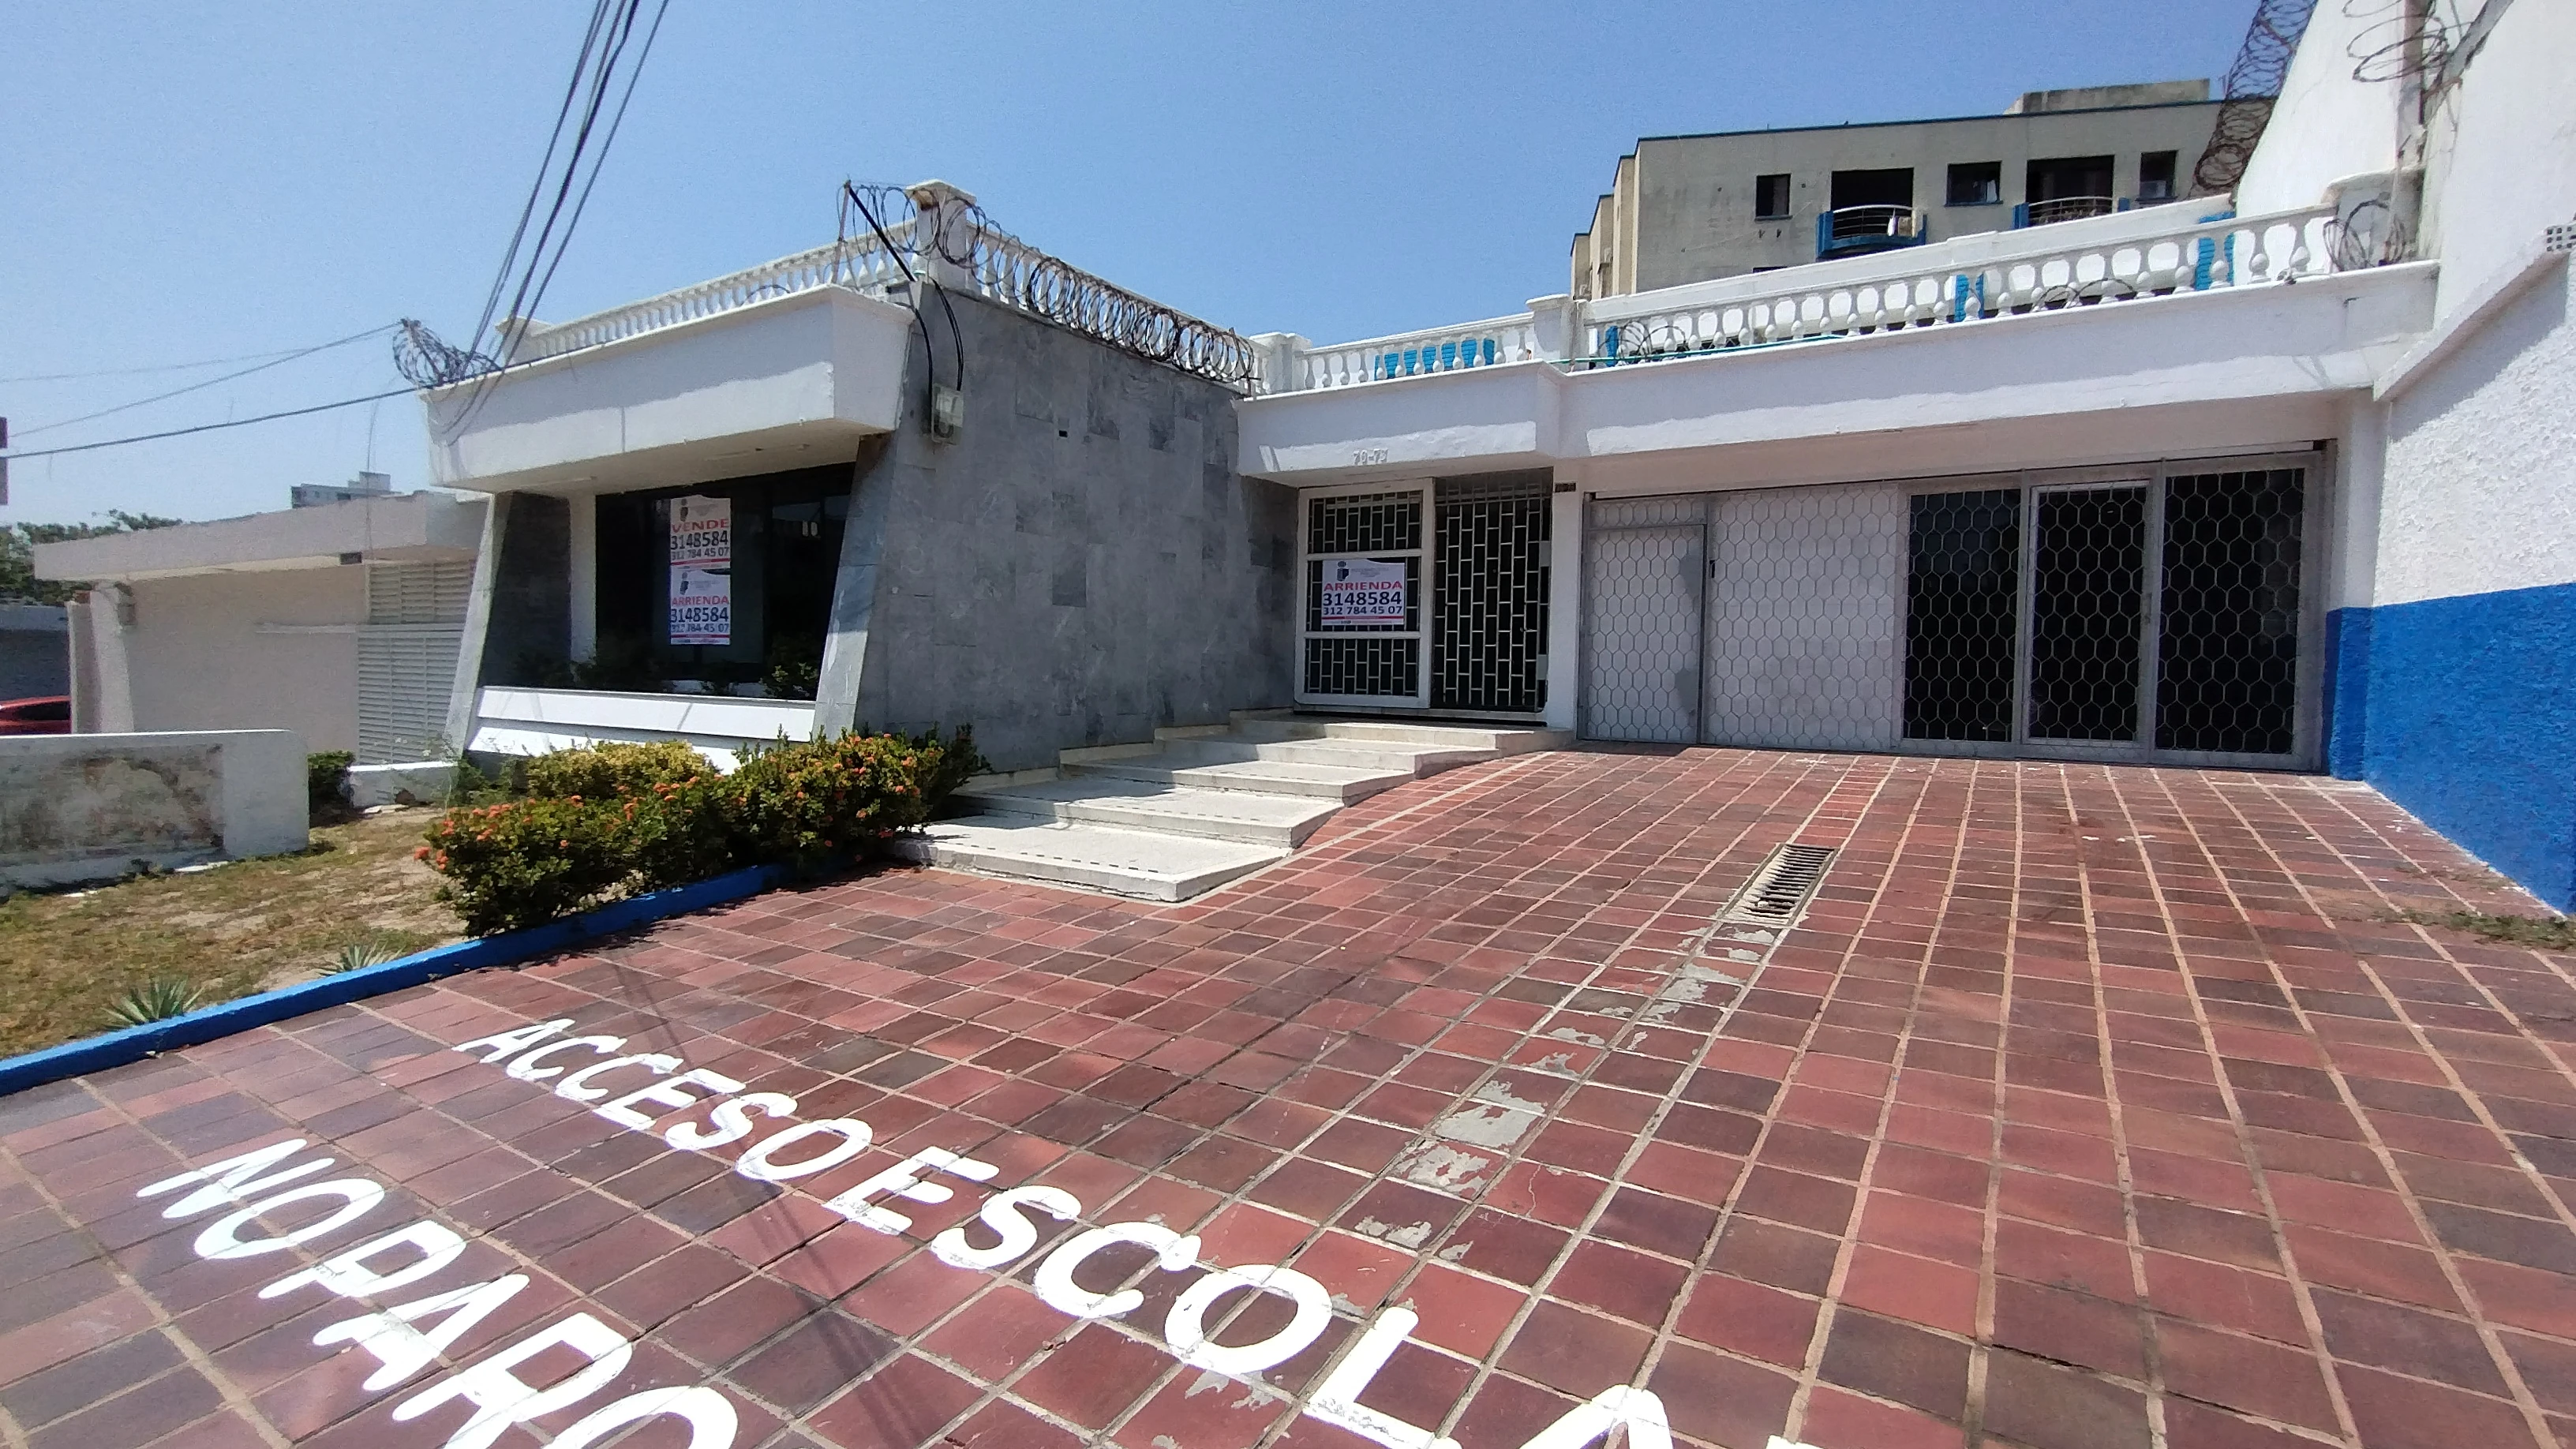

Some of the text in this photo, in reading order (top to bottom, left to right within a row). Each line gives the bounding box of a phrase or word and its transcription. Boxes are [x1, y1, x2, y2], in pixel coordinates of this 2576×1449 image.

[672, 518, 730, 533] VENDE
[671, 530, 728, 550] 3148584
[704, 548, 716, 557] 45
[718, 547, 729, 556] 07
[1324, 581, 1403, 591] ARRIENDA
[672, 595, 730, 606] ARRIENDA
[1323, 591, 1402, 606] 3148584
[671, 607, 728, 623] 3148584
[1346, 606, 1367, 615] 784
[1387, 605, 1402, 614] 07
[704, 623, 715, 632] 45
[717, 623, 729, 632] 07
[136, 1138, 386, 1260] NO
[451, 1017, 1823, 1449] ACCESO ESCOL
